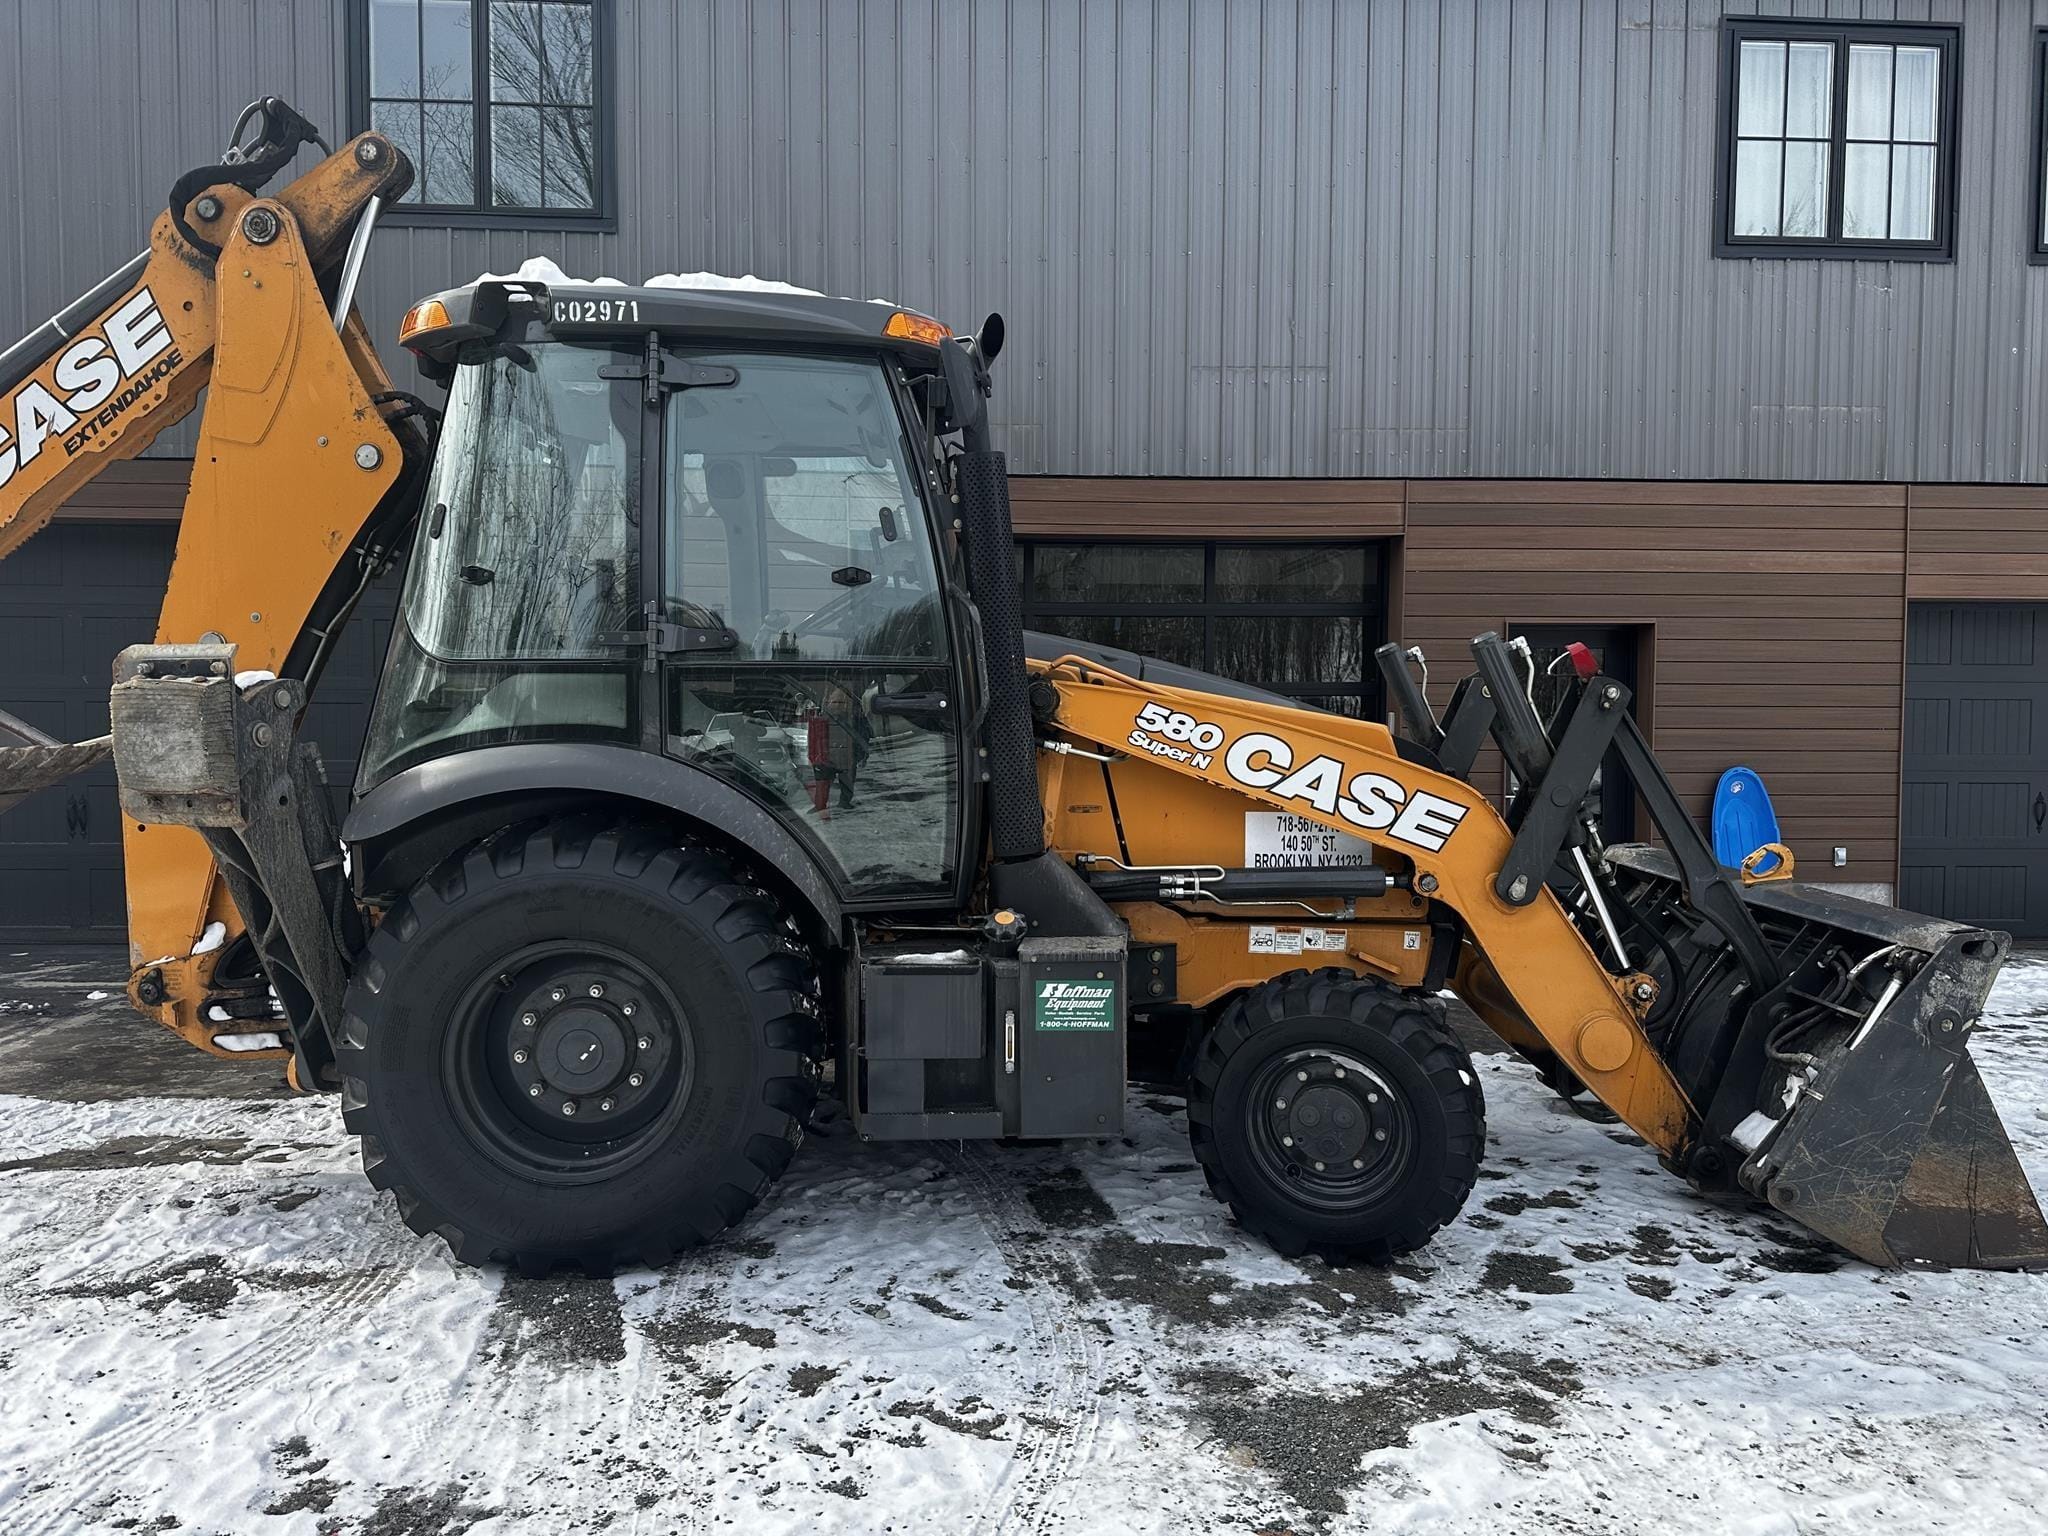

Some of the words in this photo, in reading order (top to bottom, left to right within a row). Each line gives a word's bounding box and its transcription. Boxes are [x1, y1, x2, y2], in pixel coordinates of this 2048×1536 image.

[554, 300, 639, 322] C02971
[63, 348, 184, 457] EXTENDAHOE
[1134, 701, 1225, 753] 580
[1127, 730, 1192, 765] Super
[1189, 752, 1213, 771] N
[1224, 732, 1470, 853] CASE
[1277, 816, 1341, 833] 718-567-2
[1281, 837, 1298, 852] 140
[1322, 837, 1337, 852] ST.
[1318, 854, 1333, 867] NY
[1039, 983, 1112, 998] Hoffman
[1045, 998, 1106, 1011] Equipment
